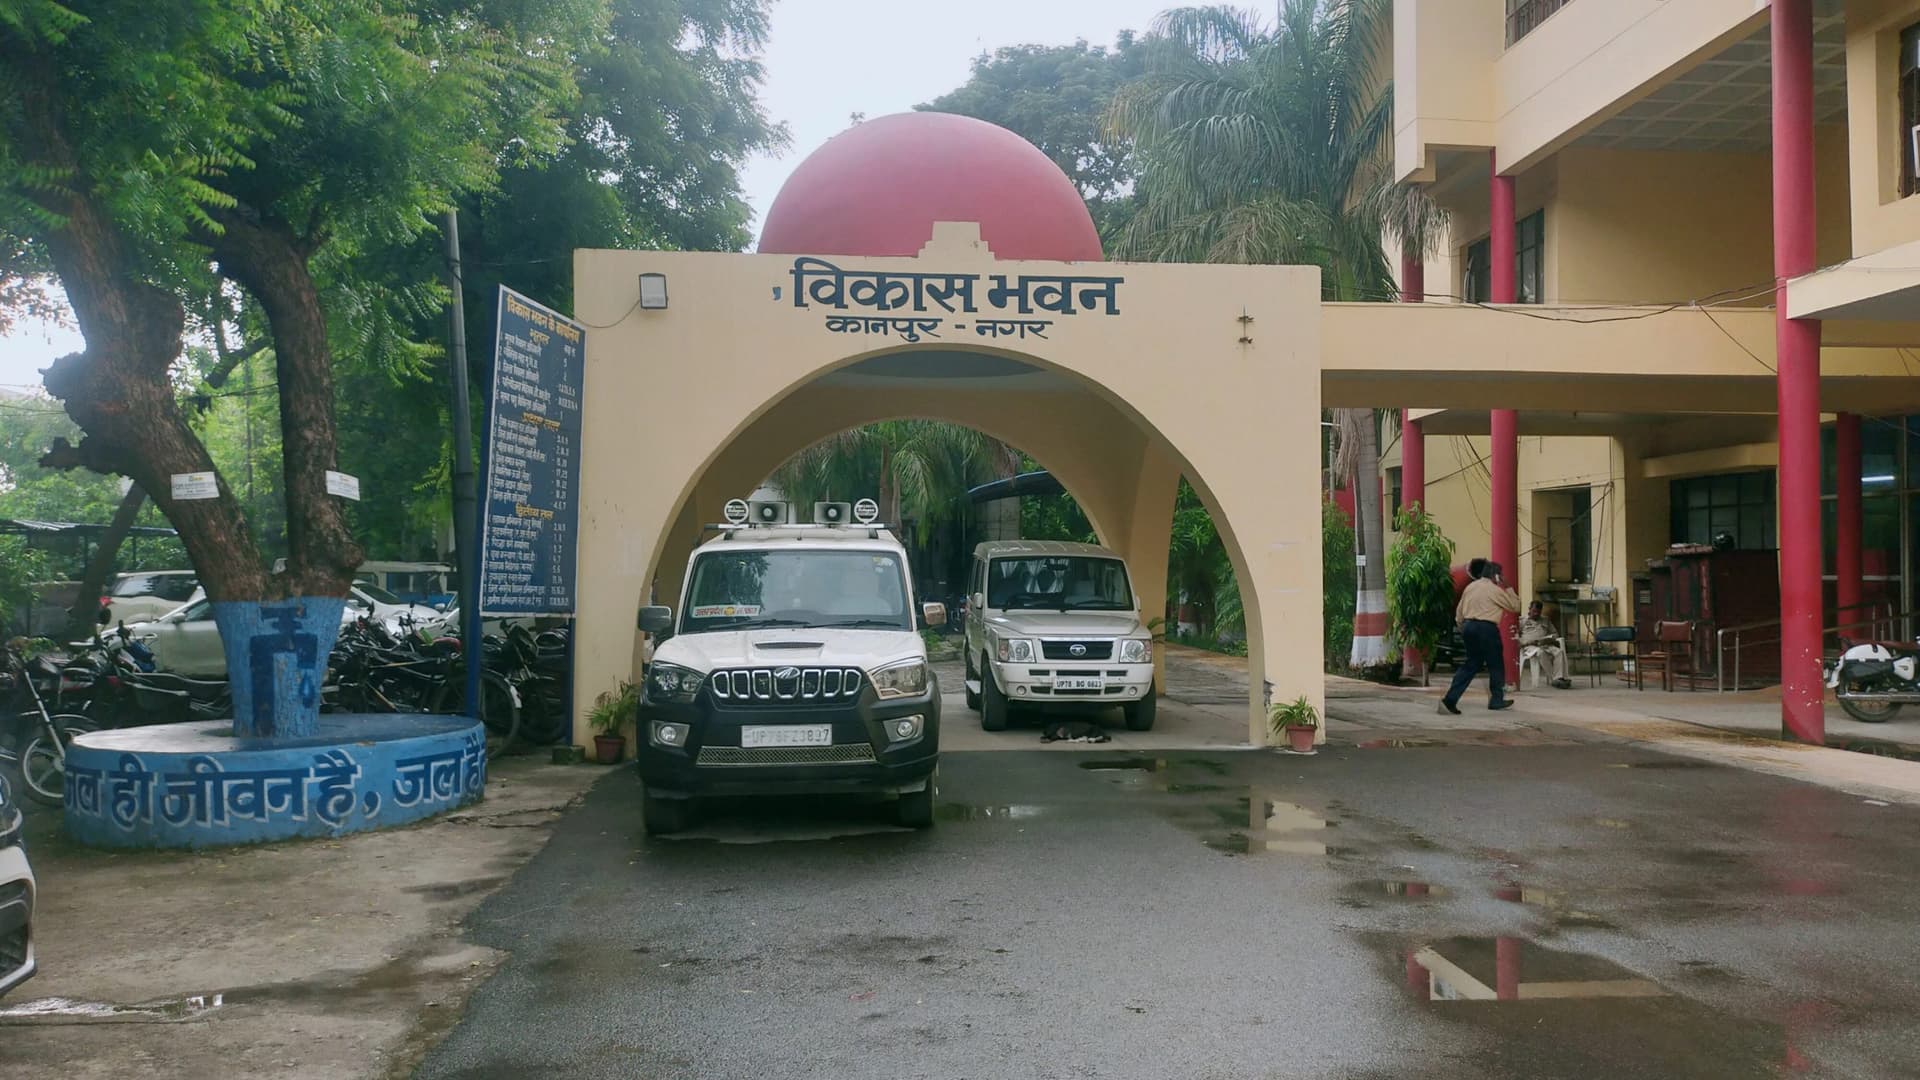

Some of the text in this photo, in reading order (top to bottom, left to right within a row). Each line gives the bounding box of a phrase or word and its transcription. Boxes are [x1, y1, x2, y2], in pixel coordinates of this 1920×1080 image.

[789, 257, 1124, 315] विकास भवन
[825, 315, 943, 342] कानपुर
[976, 319, 1053, 339] नगर
[107, 753, 158, 832] ही
[160, 755, 309, 828] जीवन
[393, 749, 464, 808] जल
